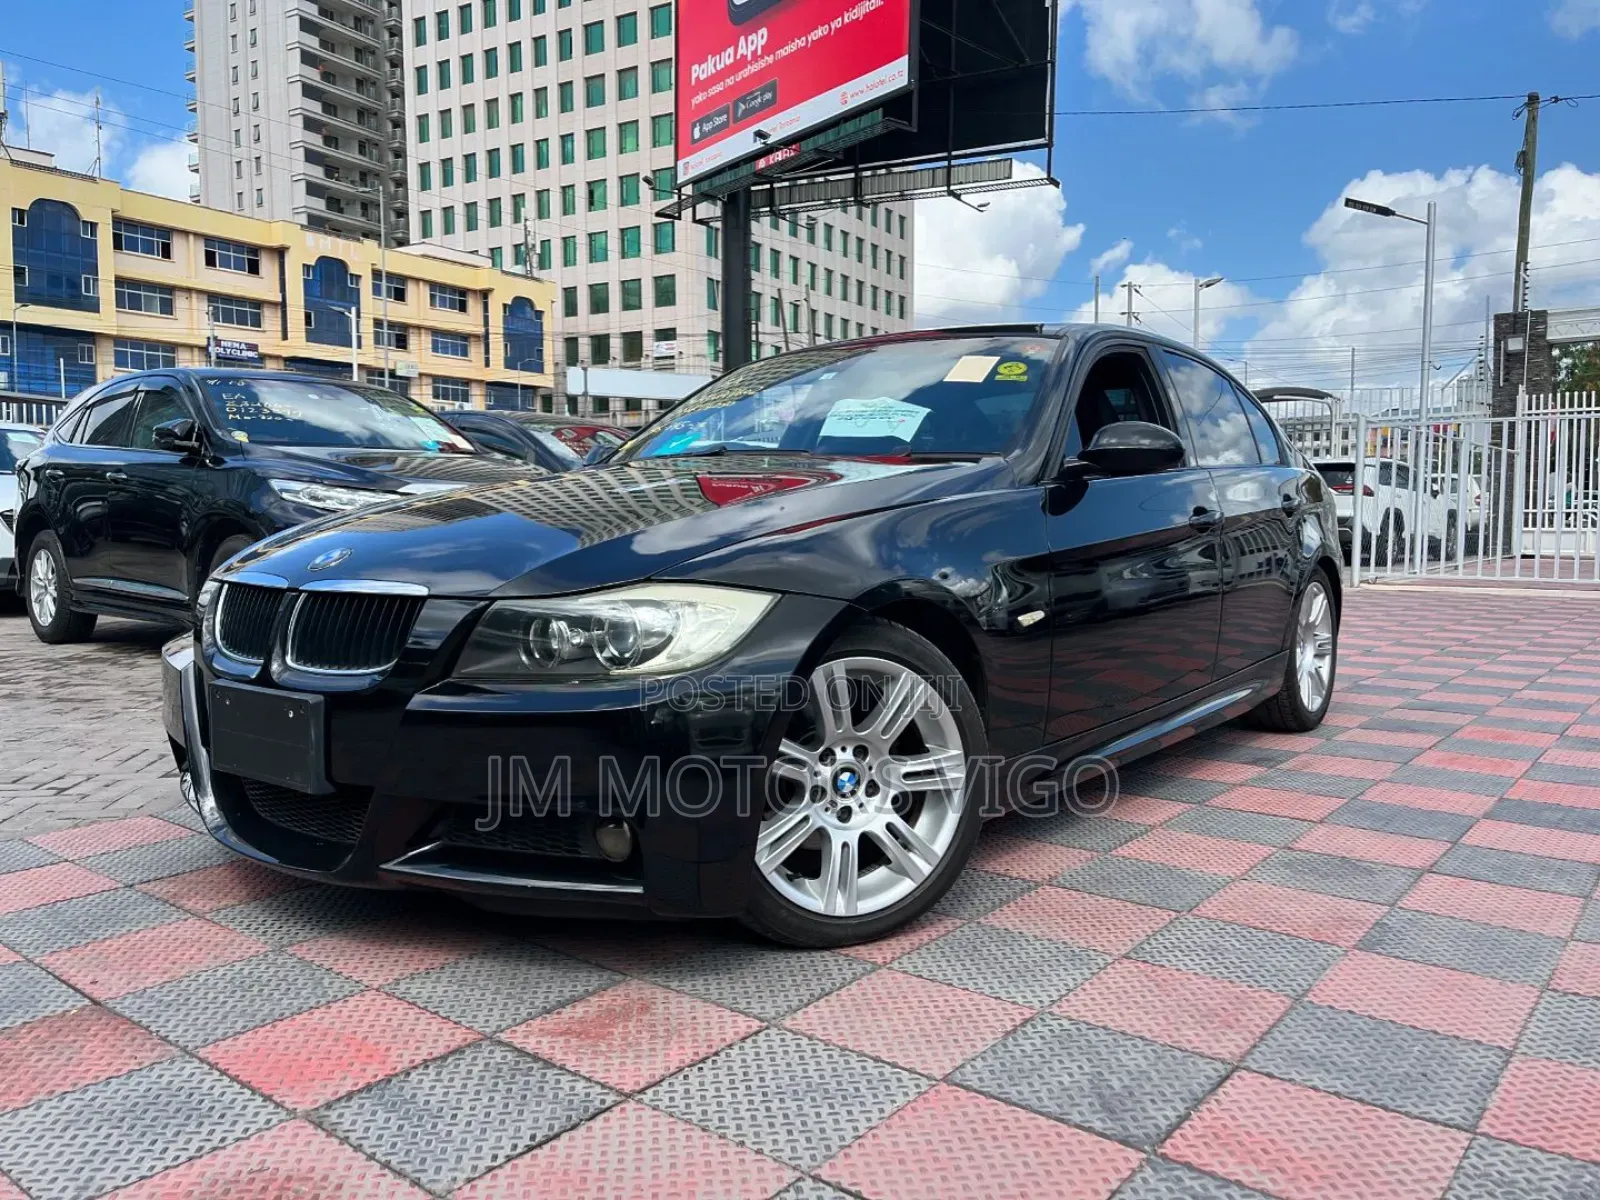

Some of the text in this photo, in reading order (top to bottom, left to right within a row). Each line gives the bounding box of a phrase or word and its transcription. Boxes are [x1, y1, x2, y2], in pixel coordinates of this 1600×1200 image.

[691, 27, 768, 86] Pakua App
[691, 91, 708, 110] yako
[707, 81, 724, 97] sasa
[725, 75, 734, 88] na
[735, 53, 774, 82] urahisishe
[775, 36, 806, 60] maisha
[807, 25, 829, 48] yako
[830, 16, 842, 36] ya
[713, 114, 728, 125] Store
